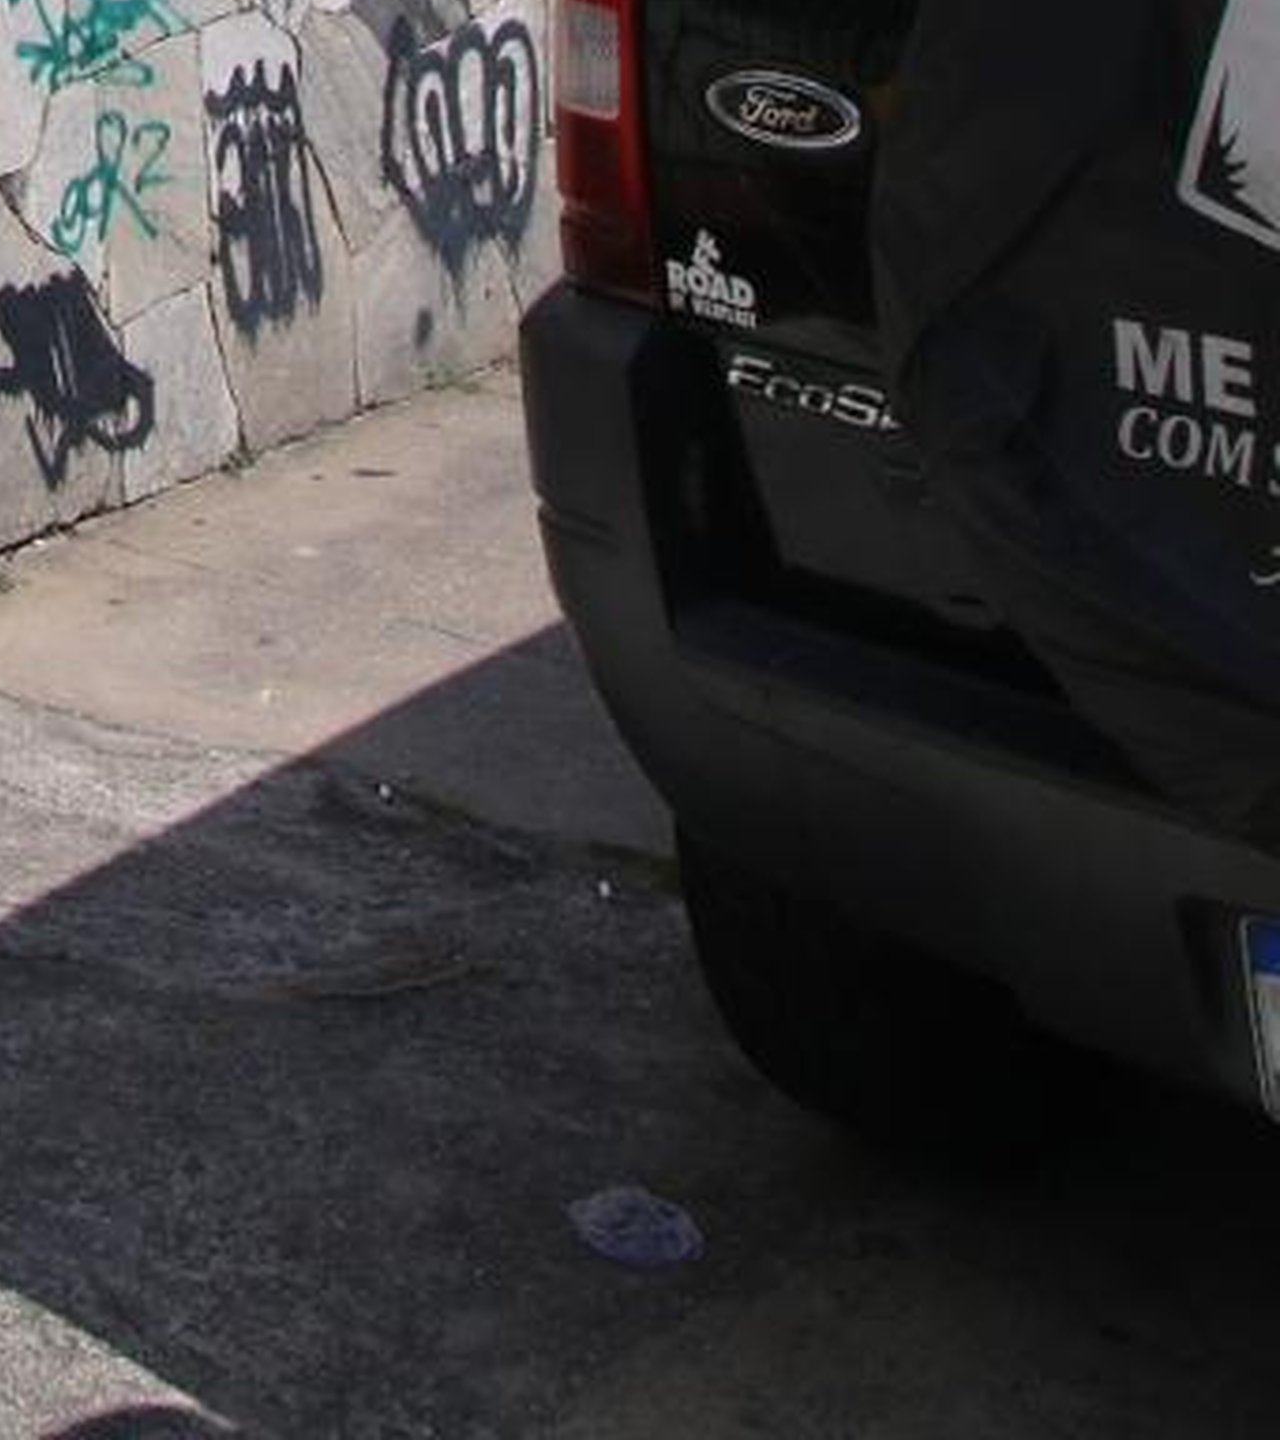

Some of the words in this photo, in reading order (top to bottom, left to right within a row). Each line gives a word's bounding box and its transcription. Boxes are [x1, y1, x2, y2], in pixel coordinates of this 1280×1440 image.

[741, 85, 818, 131] Ford
[666, 259, 756, 309] ROAD
[1113, 317, 1256, 418] ME
[1117, 406, 1256, 487] COM
